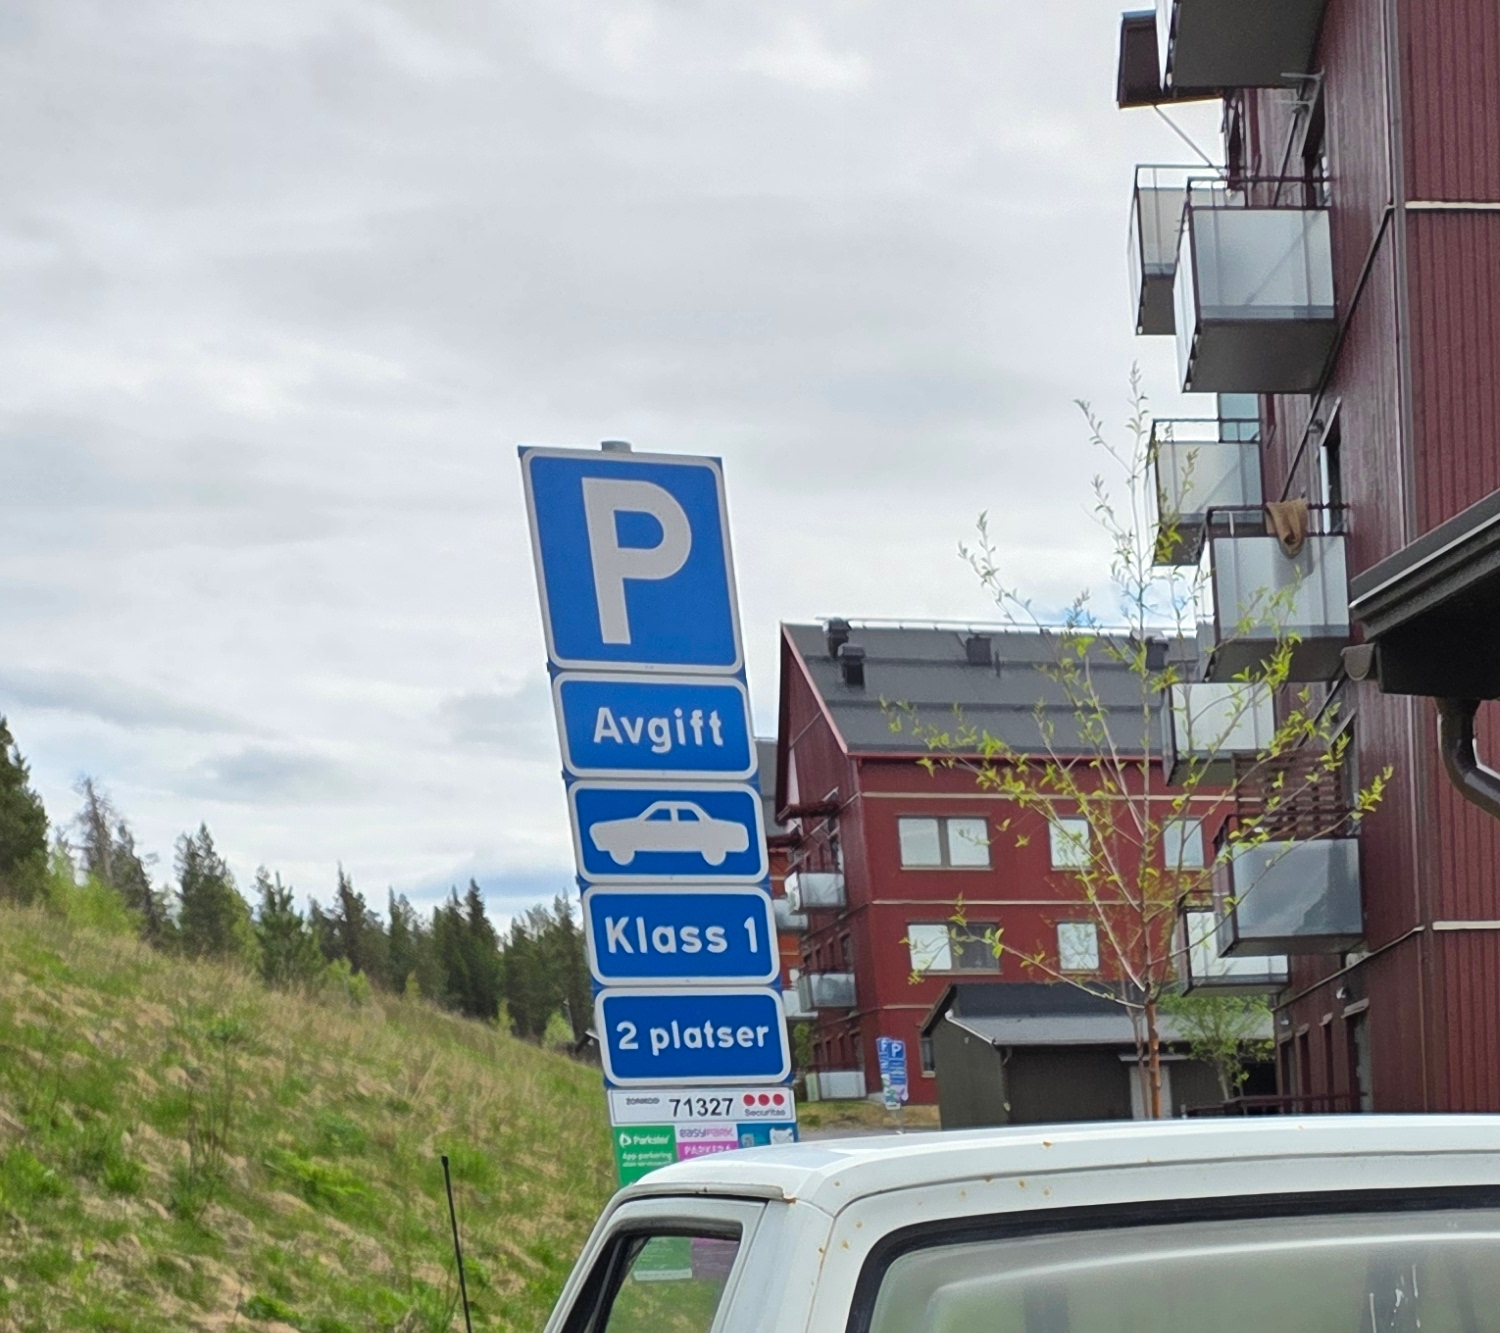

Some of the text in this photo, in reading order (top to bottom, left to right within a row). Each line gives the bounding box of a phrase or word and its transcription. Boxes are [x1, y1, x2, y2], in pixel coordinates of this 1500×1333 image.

[581, 476, 692, 645] P
[593, 706, 724, 754] Avgift
[604, 916, 758, 954] Klass 1
[616, 1019, 770, 1057] 2 platser
[891, 1043, 902, 1057] P
[669, 1097, 734, 1118] 71327
[744, 1108, 786, 1117] Securitas
